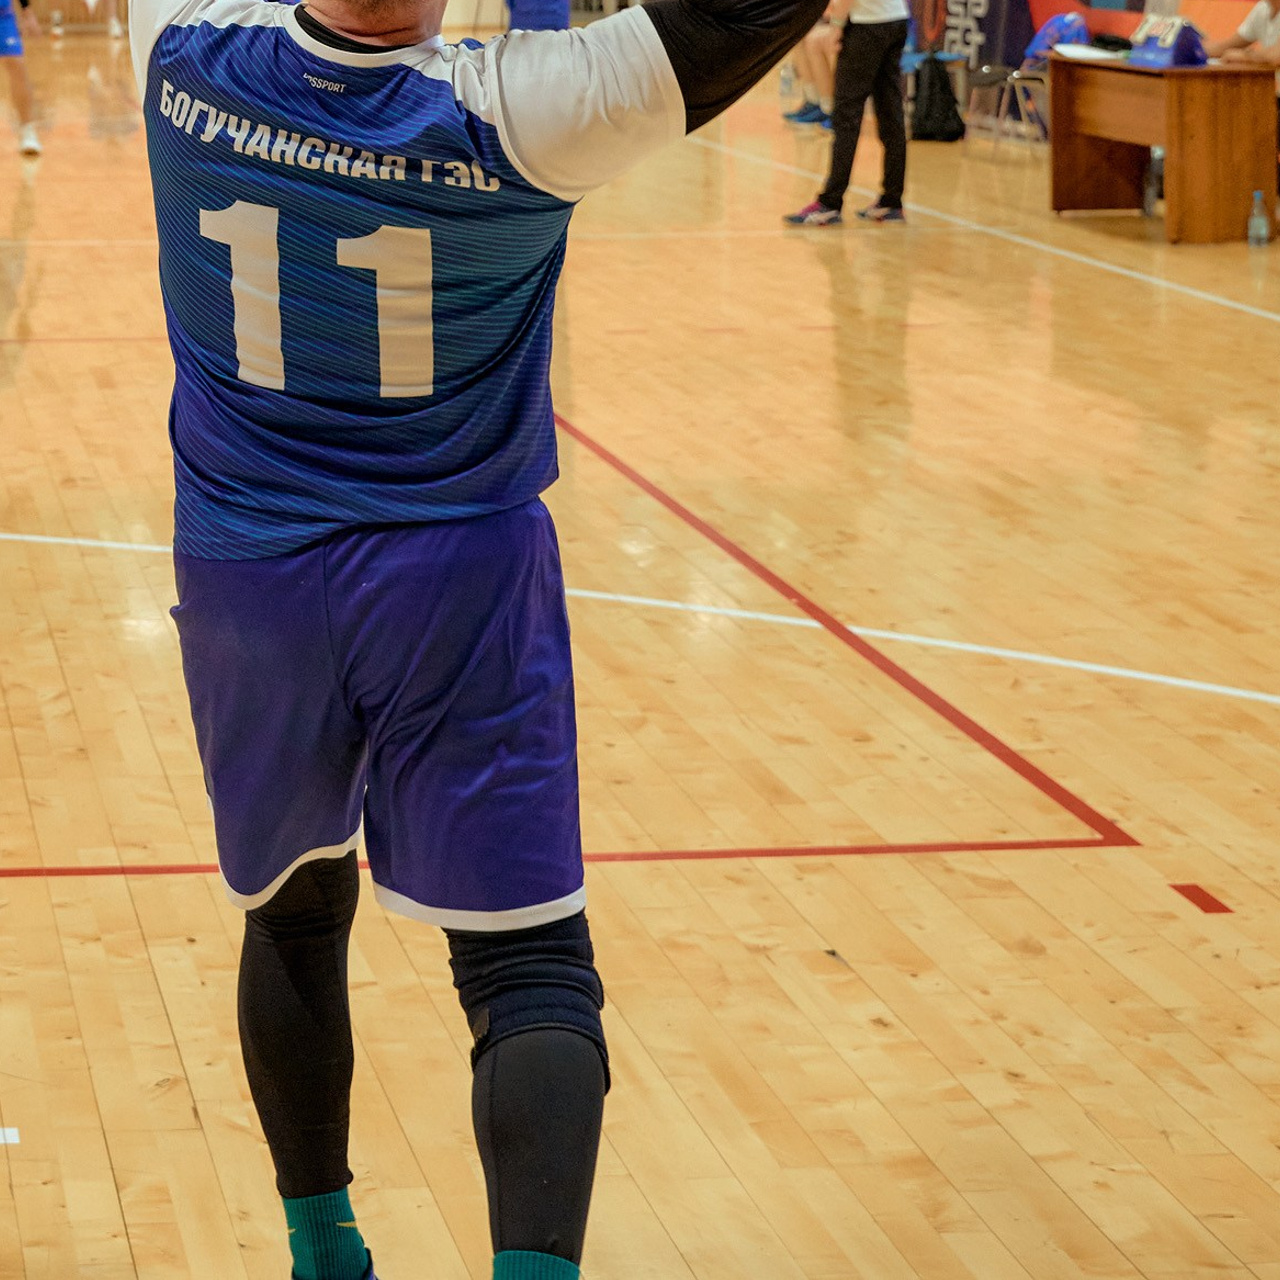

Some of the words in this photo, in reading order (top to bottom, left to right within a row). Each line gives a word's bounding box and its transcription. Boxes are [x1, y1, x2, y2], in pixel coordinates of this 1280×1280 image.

[160, 78, 407, 182] БОГУЧАНСКАЯ
[420, 159, 501, 192] ГЭС
[199, 200, 434, 398] 11
